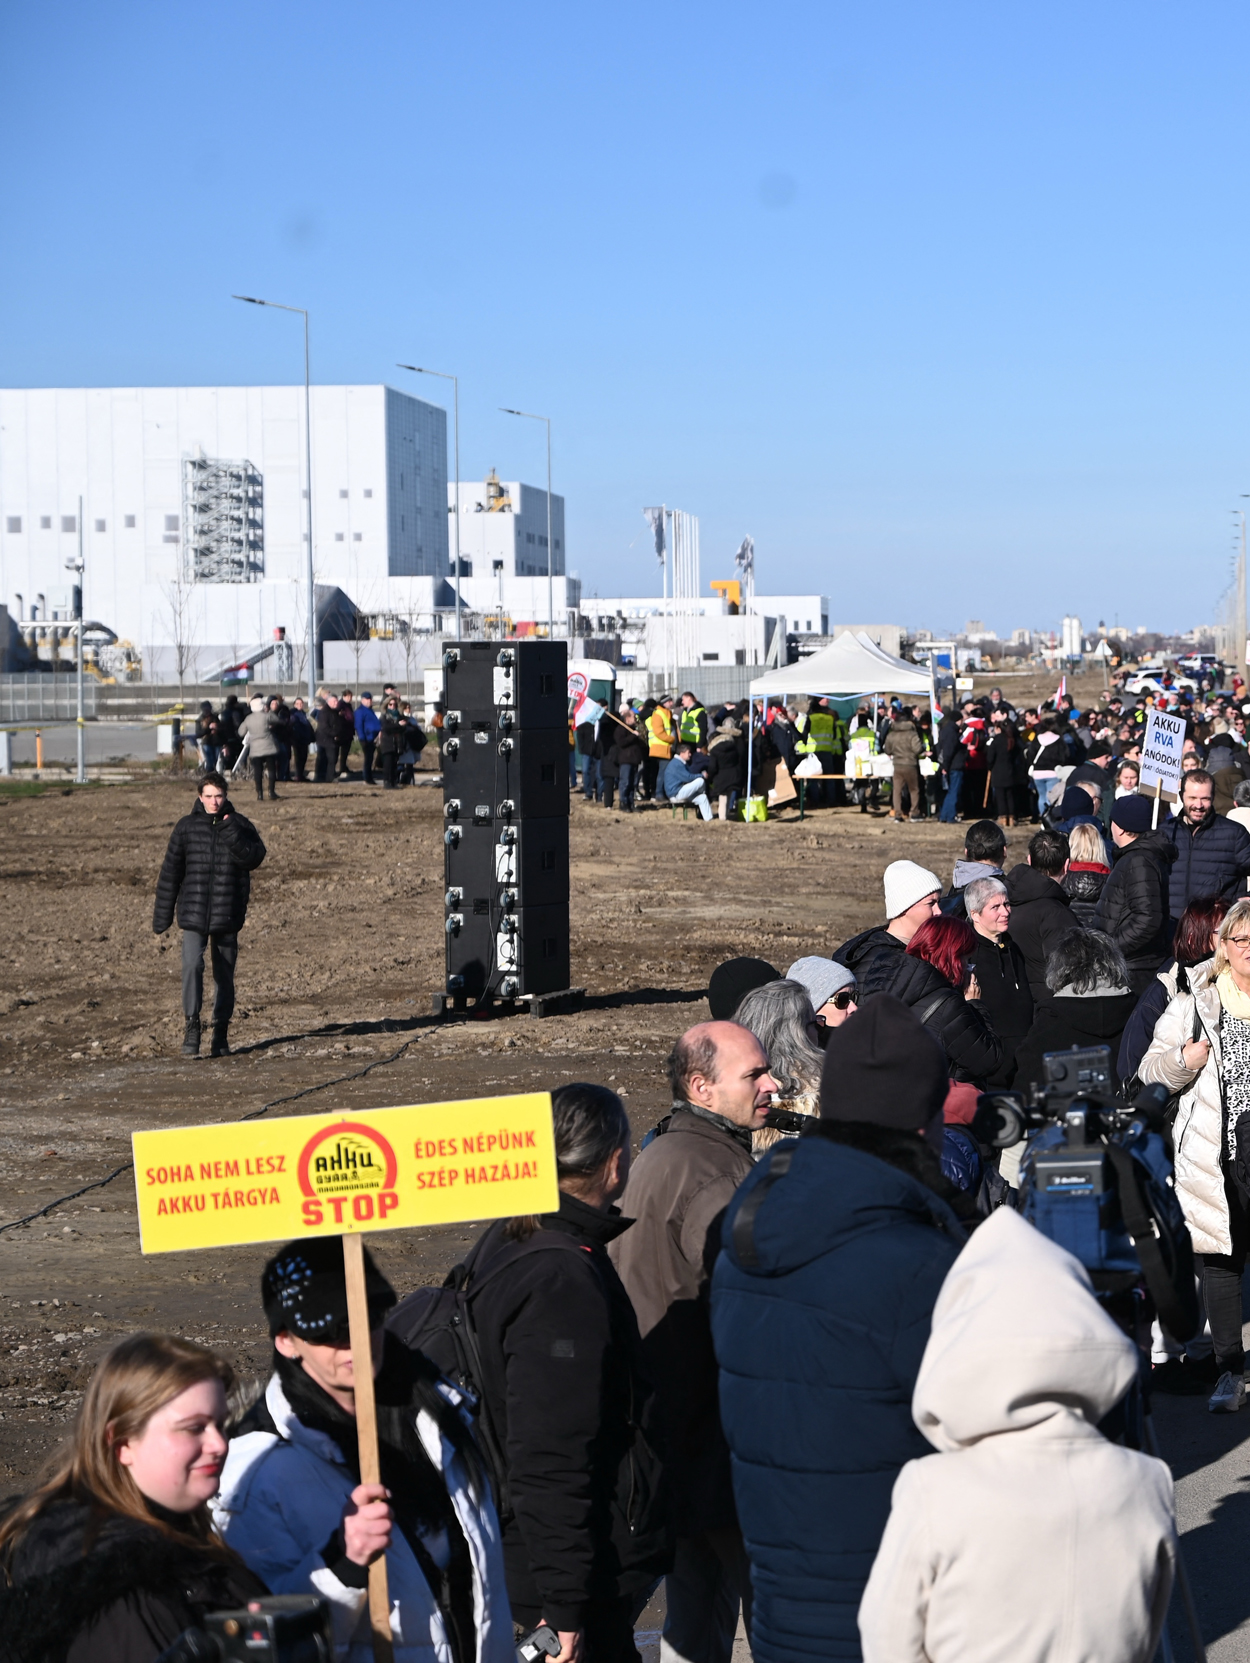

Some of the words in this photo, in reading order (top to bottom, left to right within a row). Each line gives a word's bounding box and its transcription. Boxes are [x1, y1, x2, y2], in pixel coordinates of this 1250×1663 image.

[1153, 716, 1181, 734] AKKU
[1154, 731, 1174, 748] RVA
[1144, 749, 1180, 768] ANÓDOK!
[414, 1138, 457, 1159] ÉDES
[462, 1128, 536, 1155] NÉPÜNK
[146, 1164, 195, 1186] SOHA
[200, 1159, 240, 1180] NEM
[245, 1155, 287, 1176] LESZ
[416, 1166, 459, 1190] SZÉP
[464, 1160, 538, 1185] HAZÁJA!
[157, 1194, 206, 1216] AKKU
[211, 1187, 280, 1210] TÁRGYA
[301, 1191, 399, 1226] STOP
